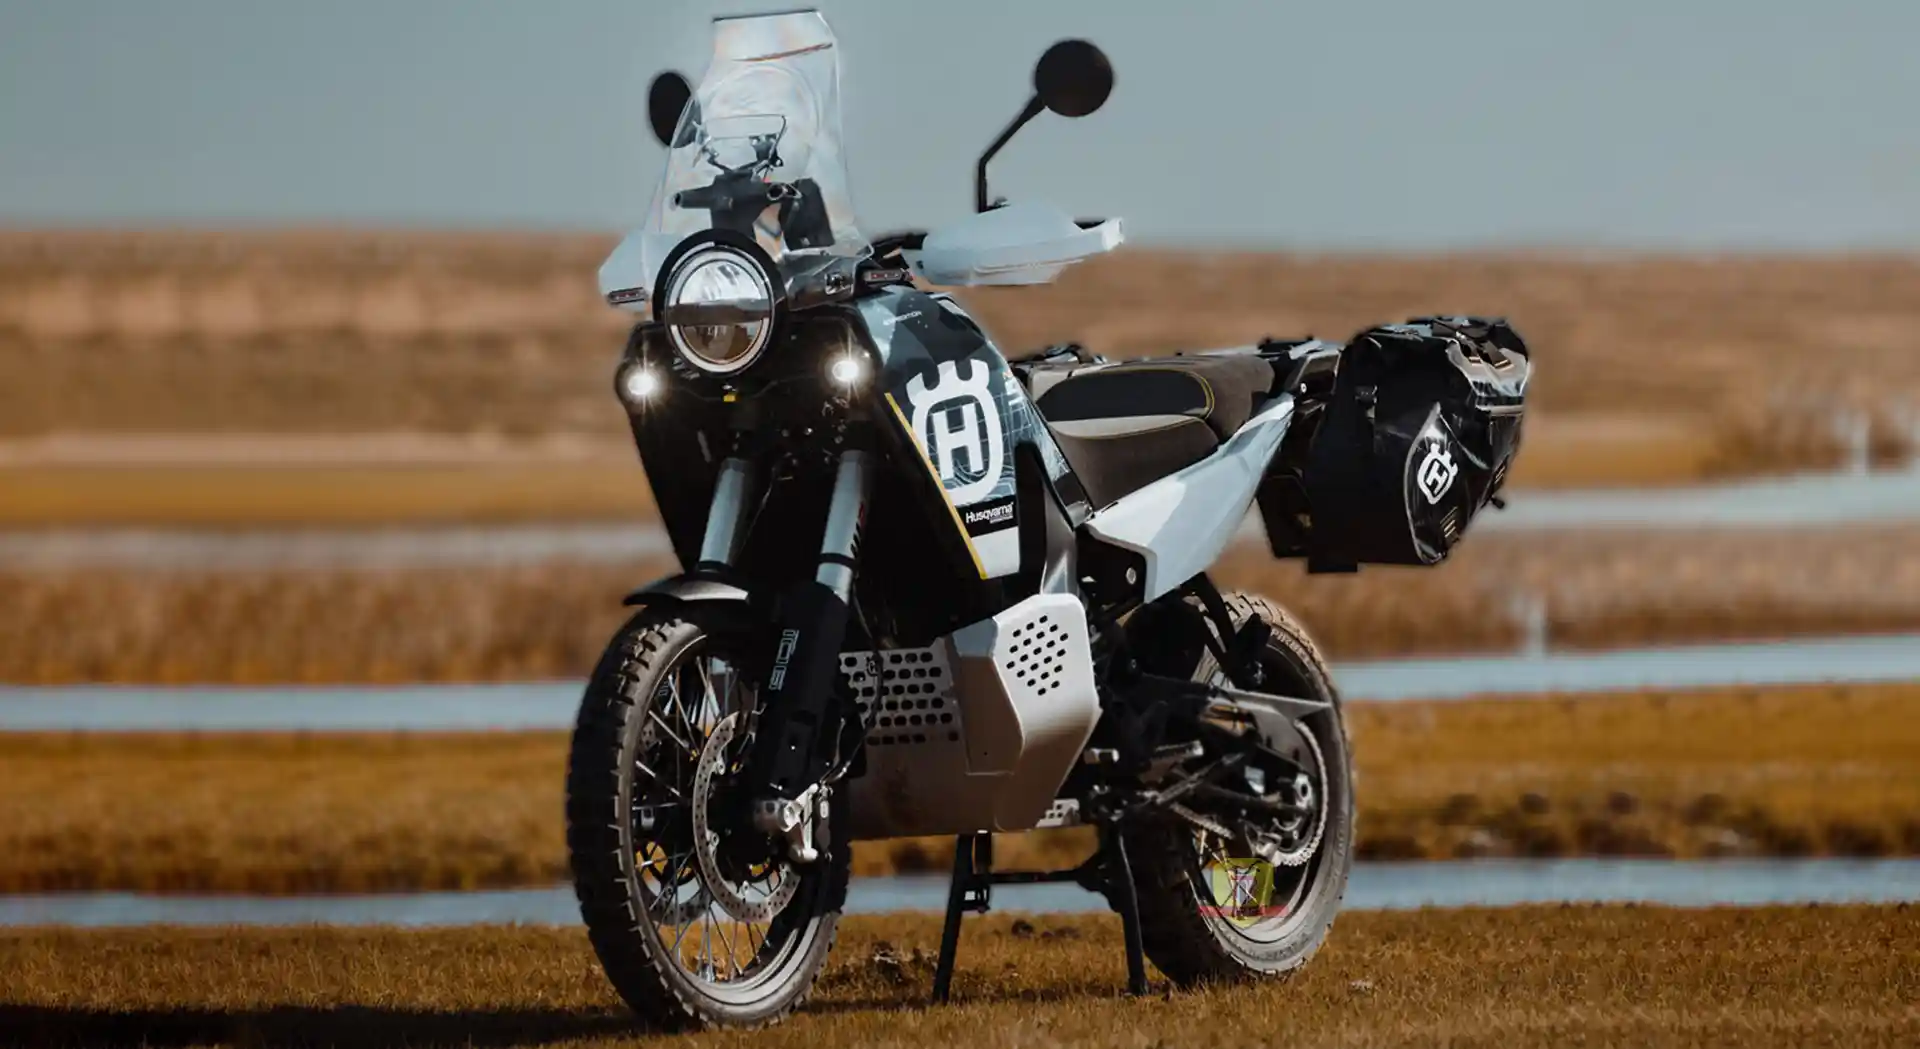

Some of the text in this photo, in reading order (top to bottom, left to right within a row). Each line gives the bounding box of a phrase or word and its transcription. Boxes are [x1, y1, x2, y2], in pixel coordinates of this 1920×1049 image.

[932, 403, 984, 481] H
[1426, 459, 1448, 495] H
[965, 504, 1013, 524] Husqvarna
